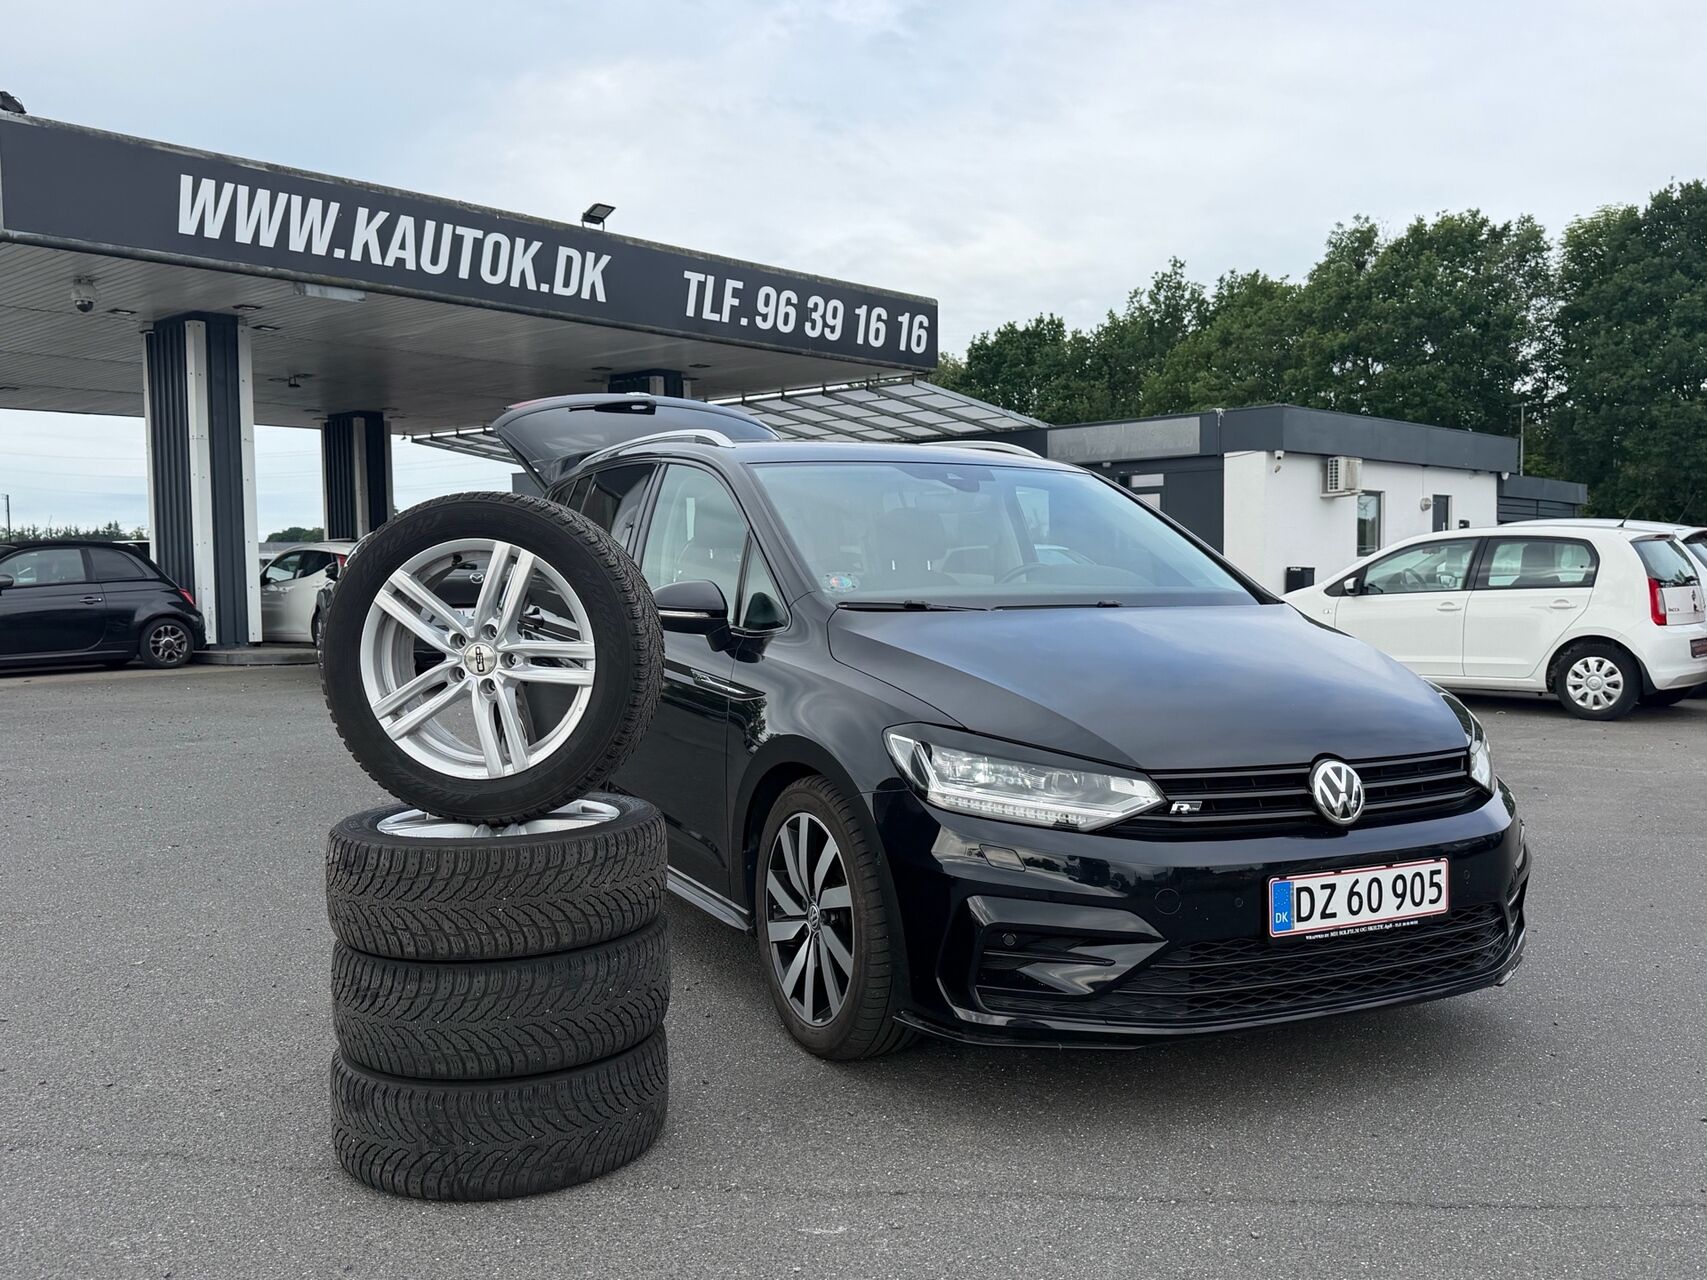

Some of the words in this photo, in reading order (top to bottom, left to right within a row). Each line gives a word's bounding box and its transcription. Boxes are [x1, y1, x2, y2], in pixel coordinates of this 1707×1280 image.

[178, 174, 612, 304] WWW.KAUTOK.DK
[684, 270, 749, 326] TLF.
[755, 285, 798, 334] 96
[804, 295, 845, 341] 39
[855, 304, 888, 348] 16
[898, 312, 930, 354] 16
[1275, 911, 1289, 924] DK
[1296, 883, 1337, 922] DZ
[1347, 877, 1383, 916] 60
[1391, 869, 1442, 911] 905
